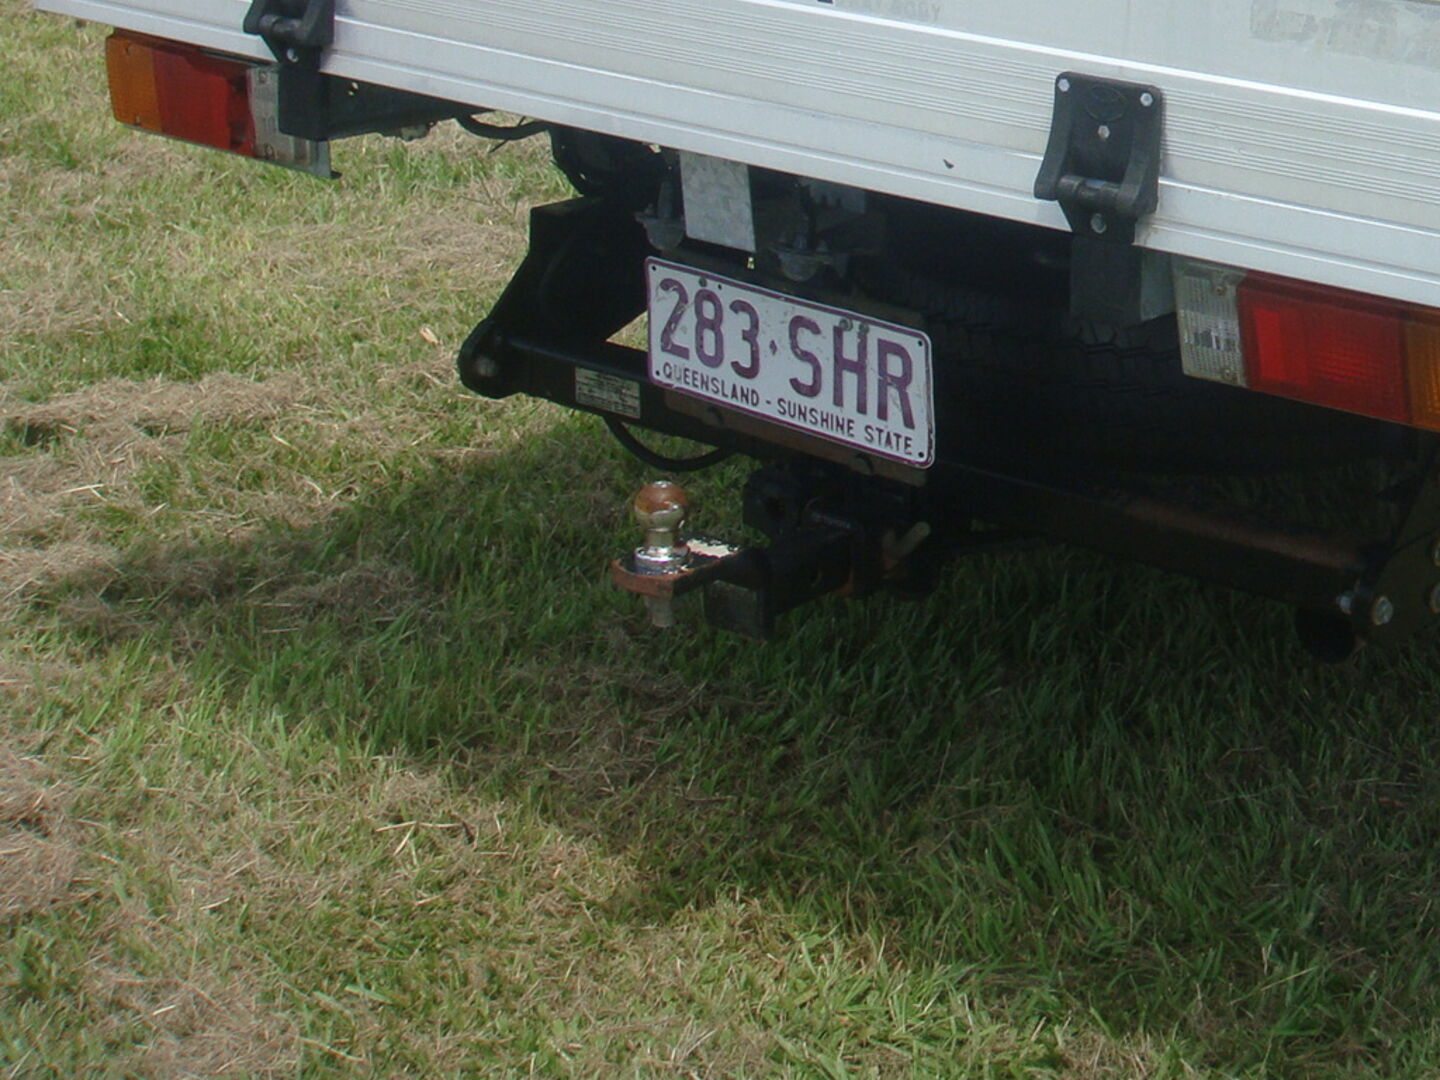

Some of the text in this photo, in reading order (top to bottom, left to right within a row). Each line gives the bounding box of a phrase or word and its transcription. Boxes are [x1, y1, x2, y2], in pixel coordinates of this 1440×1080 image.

[659, 277, 916, 430] 283 SHR
[662, 362, 760, 408] QUEENSLAND
[777, 398, 855, 439] SUNSHINE
[864, 425, 914, 456] STATE
